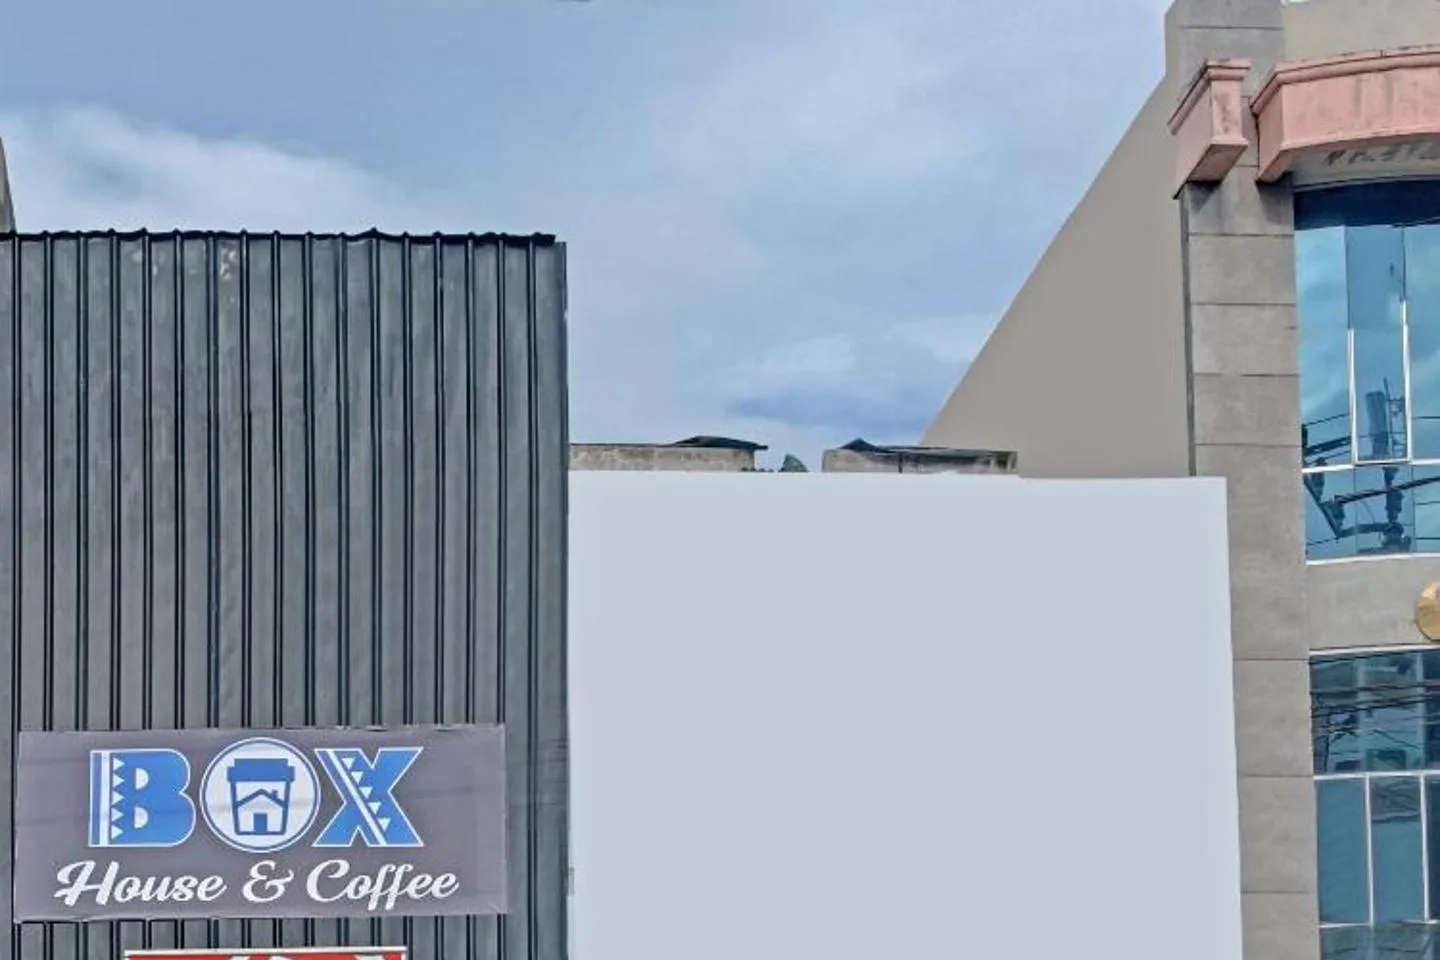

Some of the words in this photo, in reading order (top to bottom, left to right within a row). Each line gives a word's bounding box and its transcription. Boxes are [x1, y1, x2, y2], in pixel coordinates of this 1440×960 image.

[88, 737, 425, 853] BOX
[54, 860, 227, 906] House
[241, 860, 295, 902] &
[306, 859, 460, 911] Coffee
